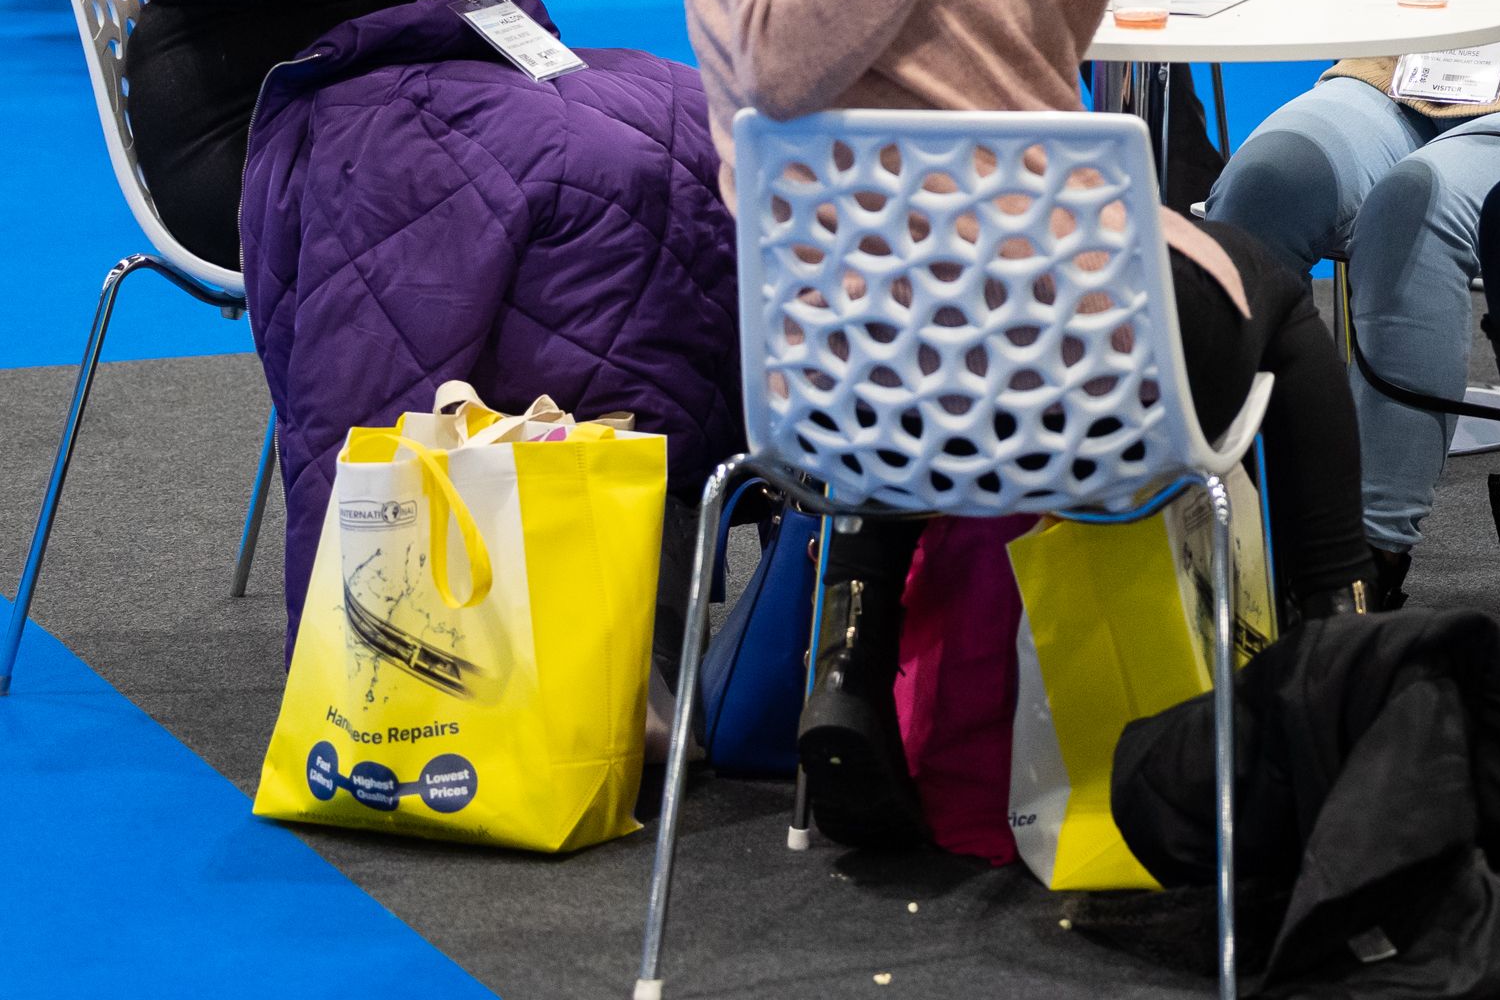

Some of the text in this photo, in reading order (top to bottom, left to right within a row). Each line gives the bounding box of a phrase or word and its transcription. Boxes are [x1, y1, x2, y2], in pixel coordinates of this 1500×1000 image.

[388, 721, 460, 744] Repairs
[352, 775, 395, 791] Highest
[426, 769, 470, 785] Lowest
[356, 789, 394, 806] Quality
[430, 785, 468, 799] Prices
